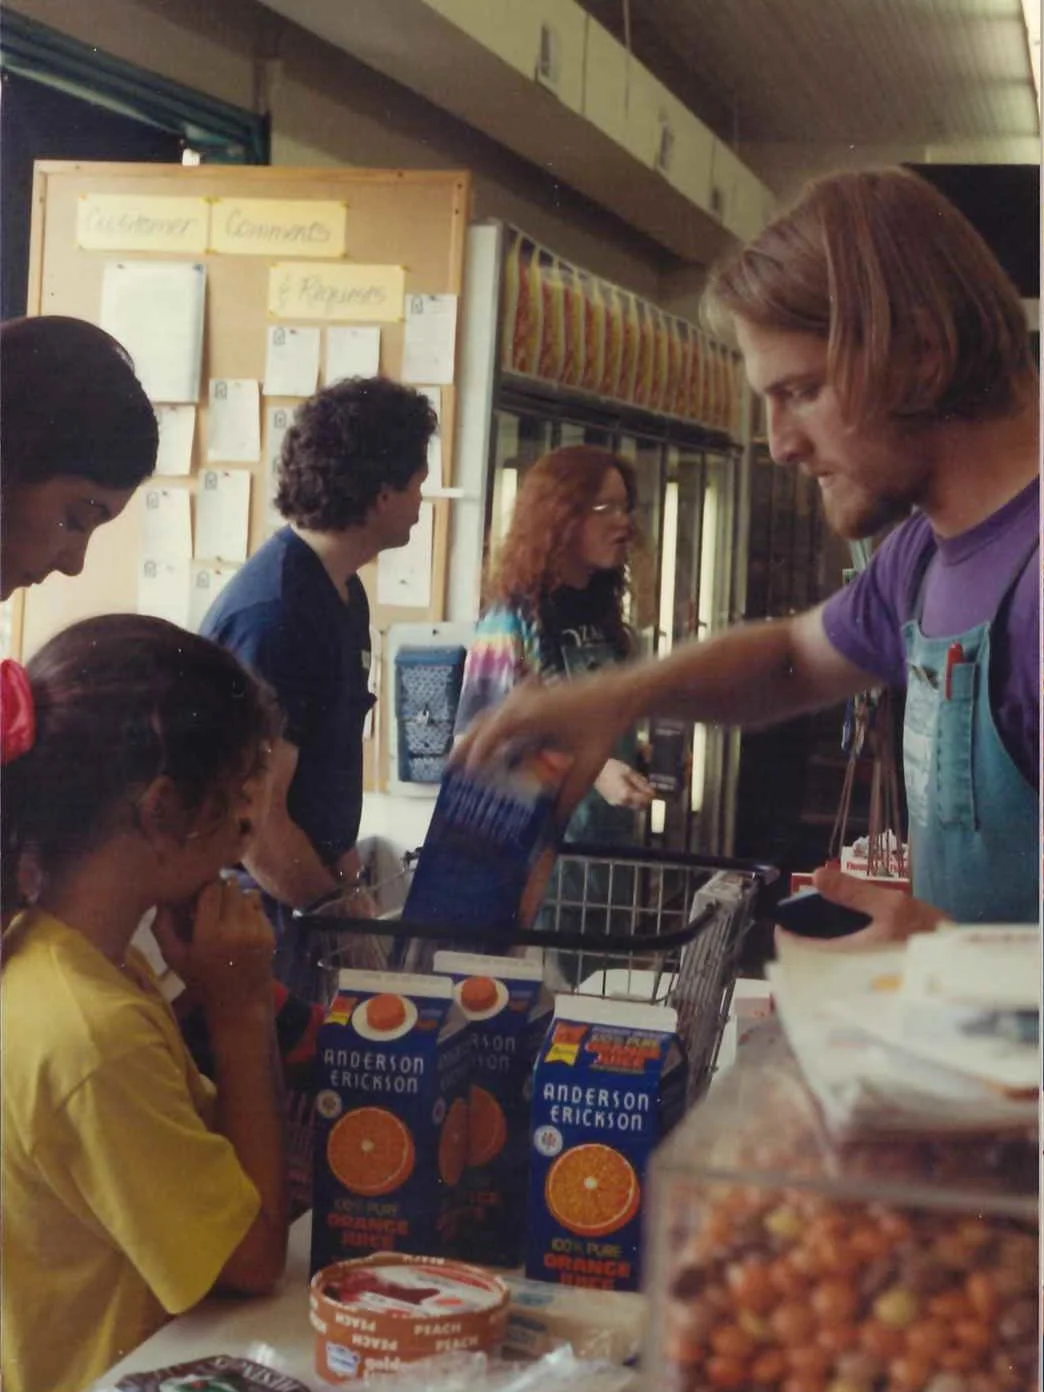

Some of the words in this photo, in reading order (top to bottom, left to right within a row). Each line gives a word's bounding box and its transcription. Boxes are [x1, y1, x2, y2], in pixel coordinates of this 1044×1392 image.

[225, 203, 331, 243] Comments
[323, 1049, 424, 1076] ANDERSON
[329, 1069, 418, 1094] ERICKSON
[543, 1082, 649, 1112] ANDERSON
[550, 1104, 642, 1131] ERICKSON
[327, 1212, 409, 1236] ORANGE
[586, 1241, 620, 1259] PURE
[543, 1252, 631, 1278] ORANGE
[351, 1333, 399, 1352] PEACH
[413, 1322, 463, 1338] PEACH
[434, 1335, 480, 1352] PEACH
